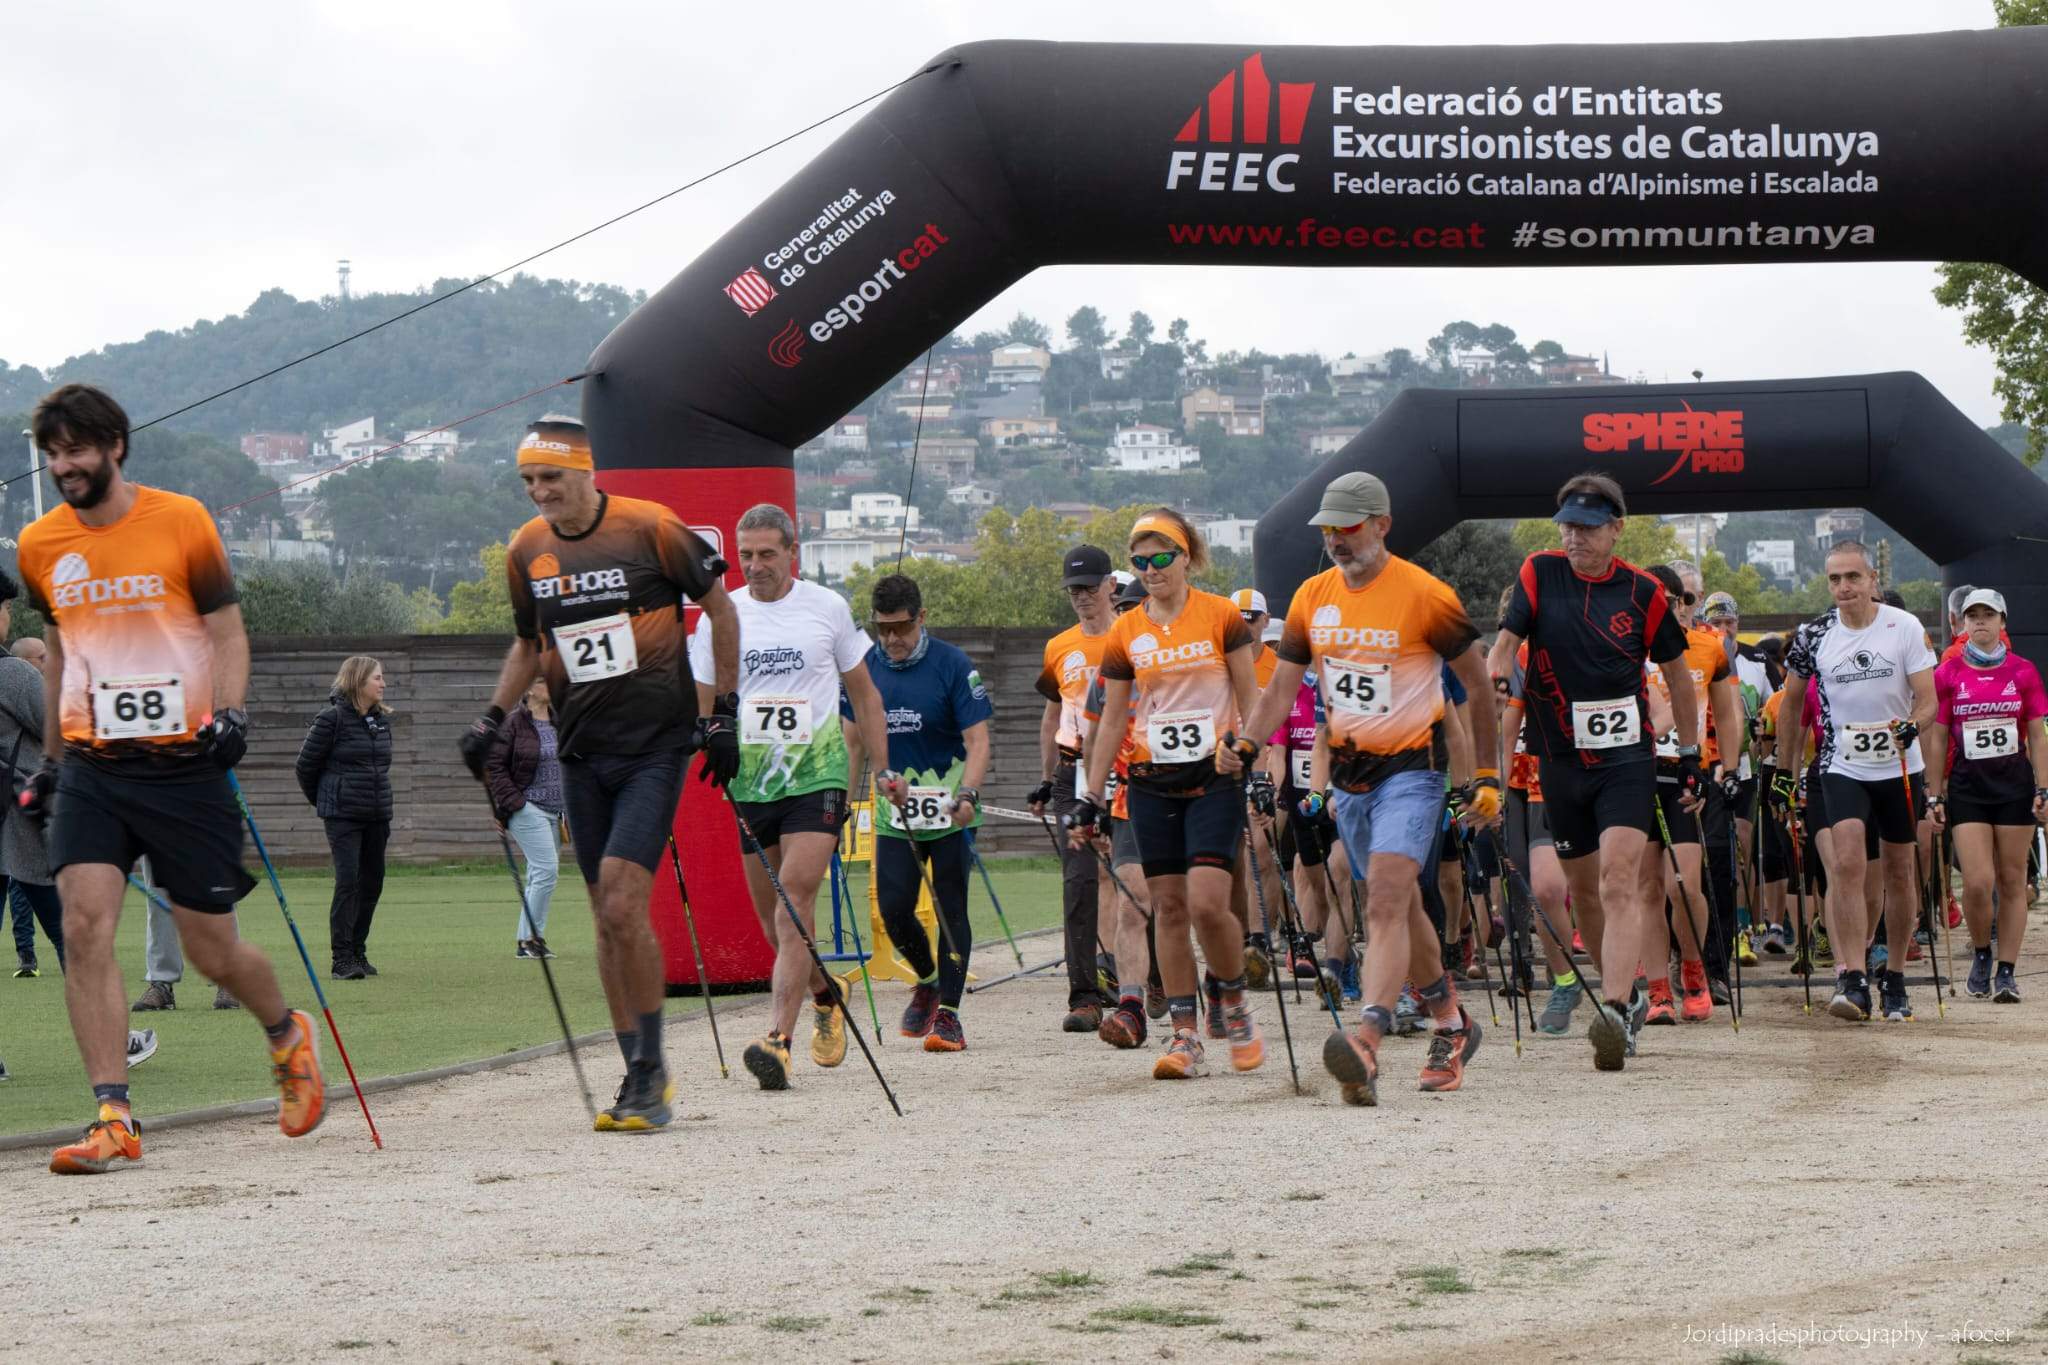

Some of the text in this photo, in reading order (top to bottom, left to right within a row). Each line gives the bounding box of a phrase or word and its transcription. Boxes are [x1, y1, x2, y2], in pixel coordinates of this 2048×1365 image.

[1332, 86, 1523, 115] Federació
[1333, 124, 1879, 166] Excursionistes de Catalunya
[1166, 151, 1299, 193] FEEC
[1333, 172, 1461, 195] Federació
[1467, 173, 1582, 195] Catalana
[1750, 173, 1757, 194] i
[1765, 170, 1878, 193] Escalada
[763, 187, 863, 270] Generalitat
[780, 189, 896, 287] de Catalunya
[1168, 218, 1876, 250] www.feec.cat #sommuntanya
[809, 223, 949, 342] esportcat
[1583, 411, 1744, 452] SPHERE
[1692, 450, 1744, 473] PRO
[573, 632, 614, 667] 21
[743, 646, 805, 675] Bastons
[758, 667, 792, 676] AMUNT
[1336, 673, 1375, 702] 45
[115, 691, 166, 722] 68
[756, 706, 797, 731] 78
[1161, 723, 1202, 750] 33
[1587, 710, 1628, 737] 62
[1854, 732, 1889, 752] 32
[1975, 728, 2008, 749] 58
[904, 797, 939, 819] 86
